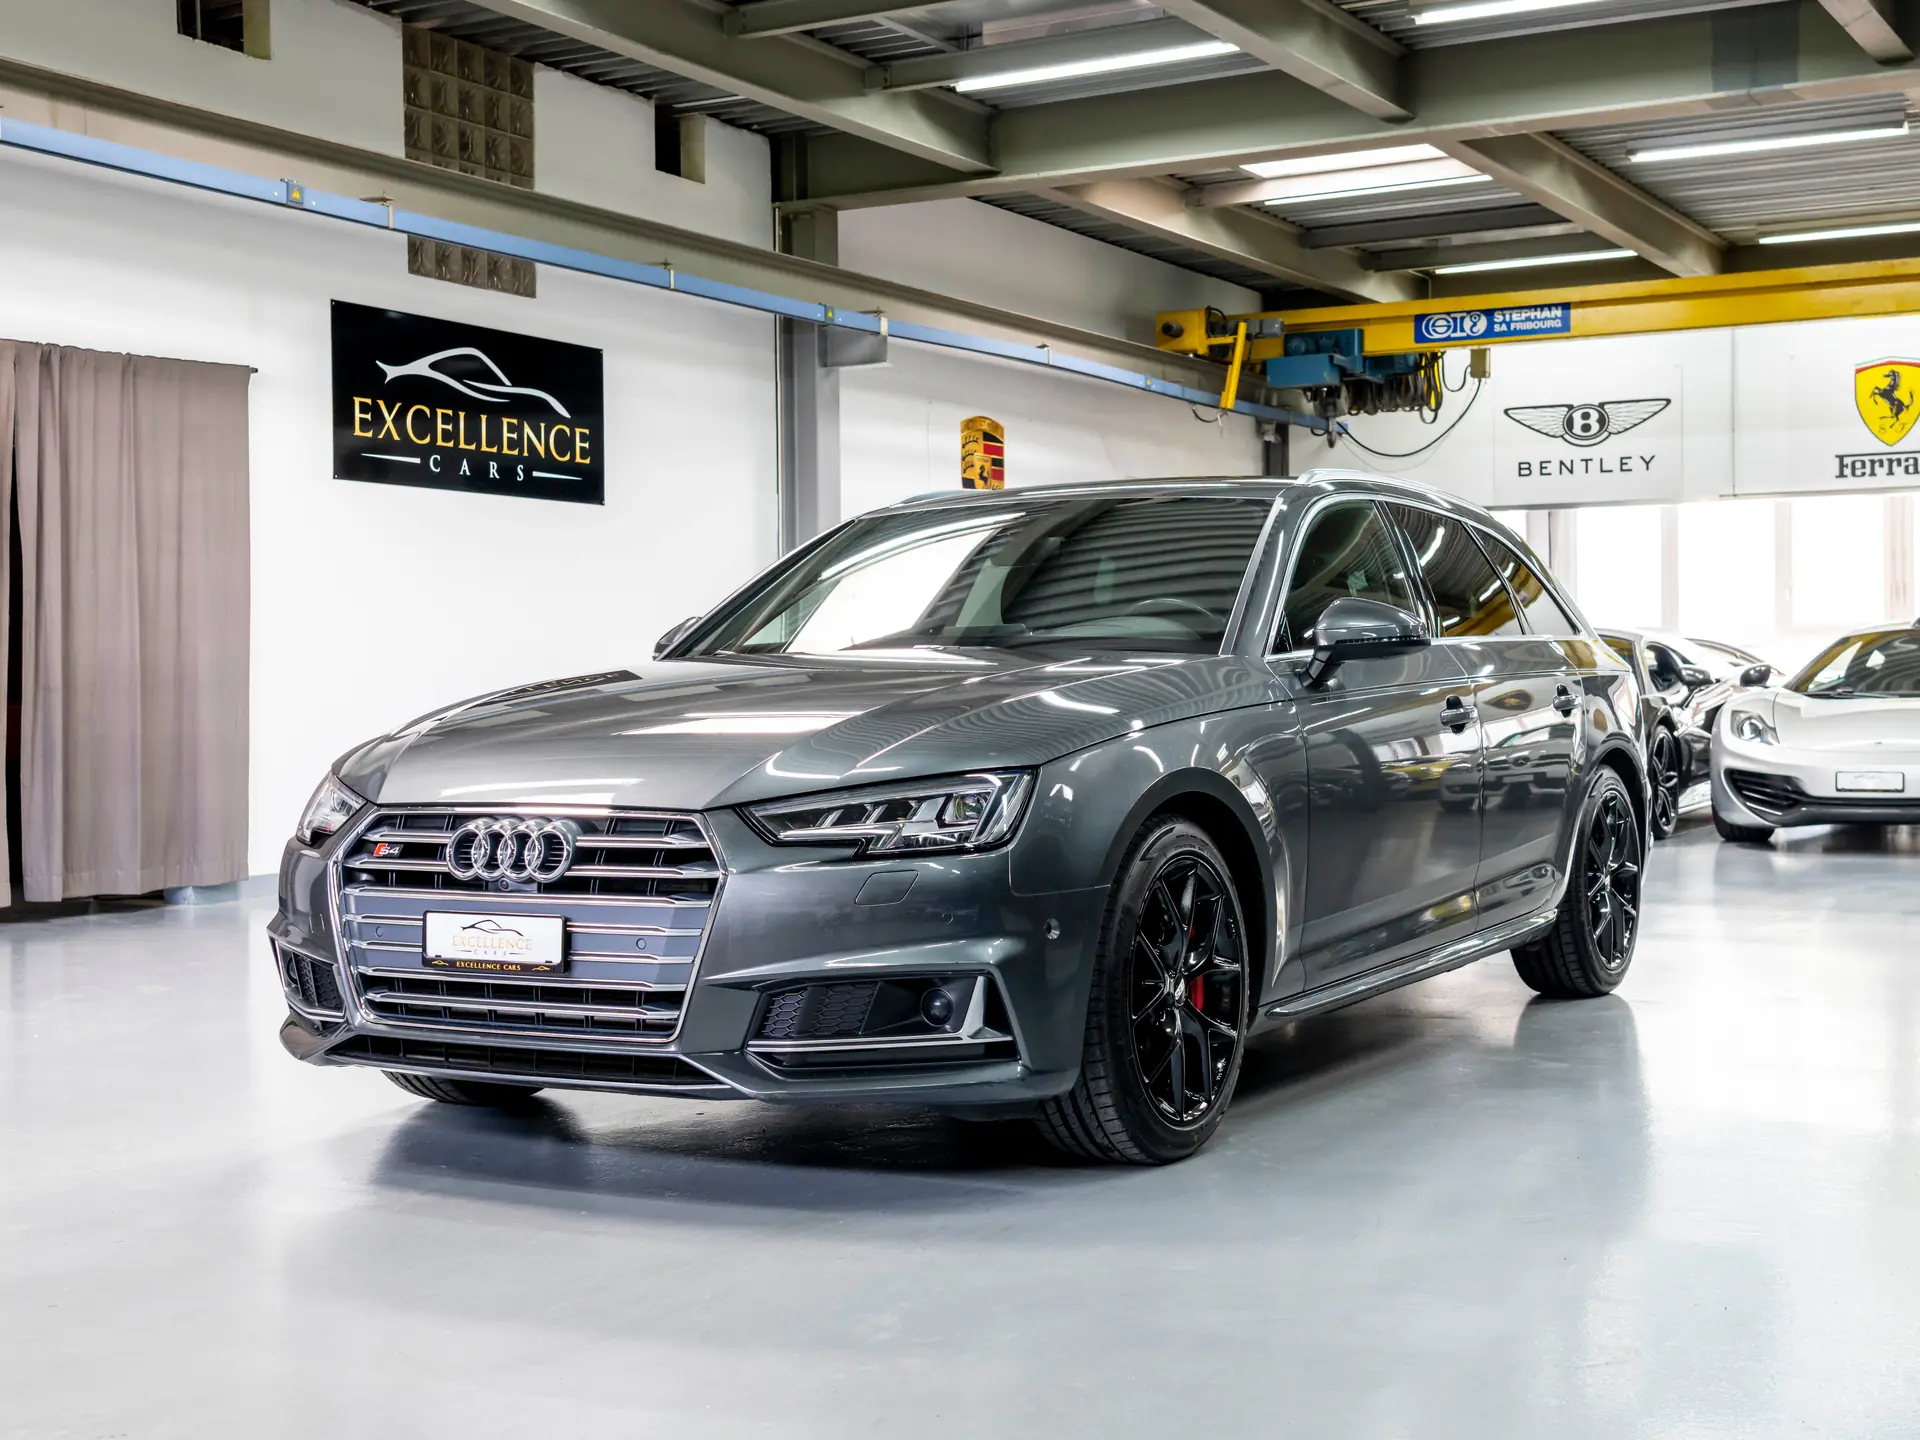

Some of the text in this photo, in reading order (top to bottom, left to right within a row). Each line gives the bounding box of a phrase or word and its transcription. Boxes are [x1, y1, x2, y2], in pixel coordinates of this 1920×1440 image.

[1493, 306, 1562, 323] STEPHAN
[1493, 323, 1508, 333] SA
[1510, 319, 1562, 332] FRIBOURG
[353, 396, 592, 465] EXCELLENCE
[1571, 408, 1600, 437] B
[429, 454, 525, 481] CARS
[1517, 455, 1656, 478] BENTLEY
[452, 935, 533, 951] EXCELLENCE
[456, 960, 521, 971] EXCELLENCE CARS
